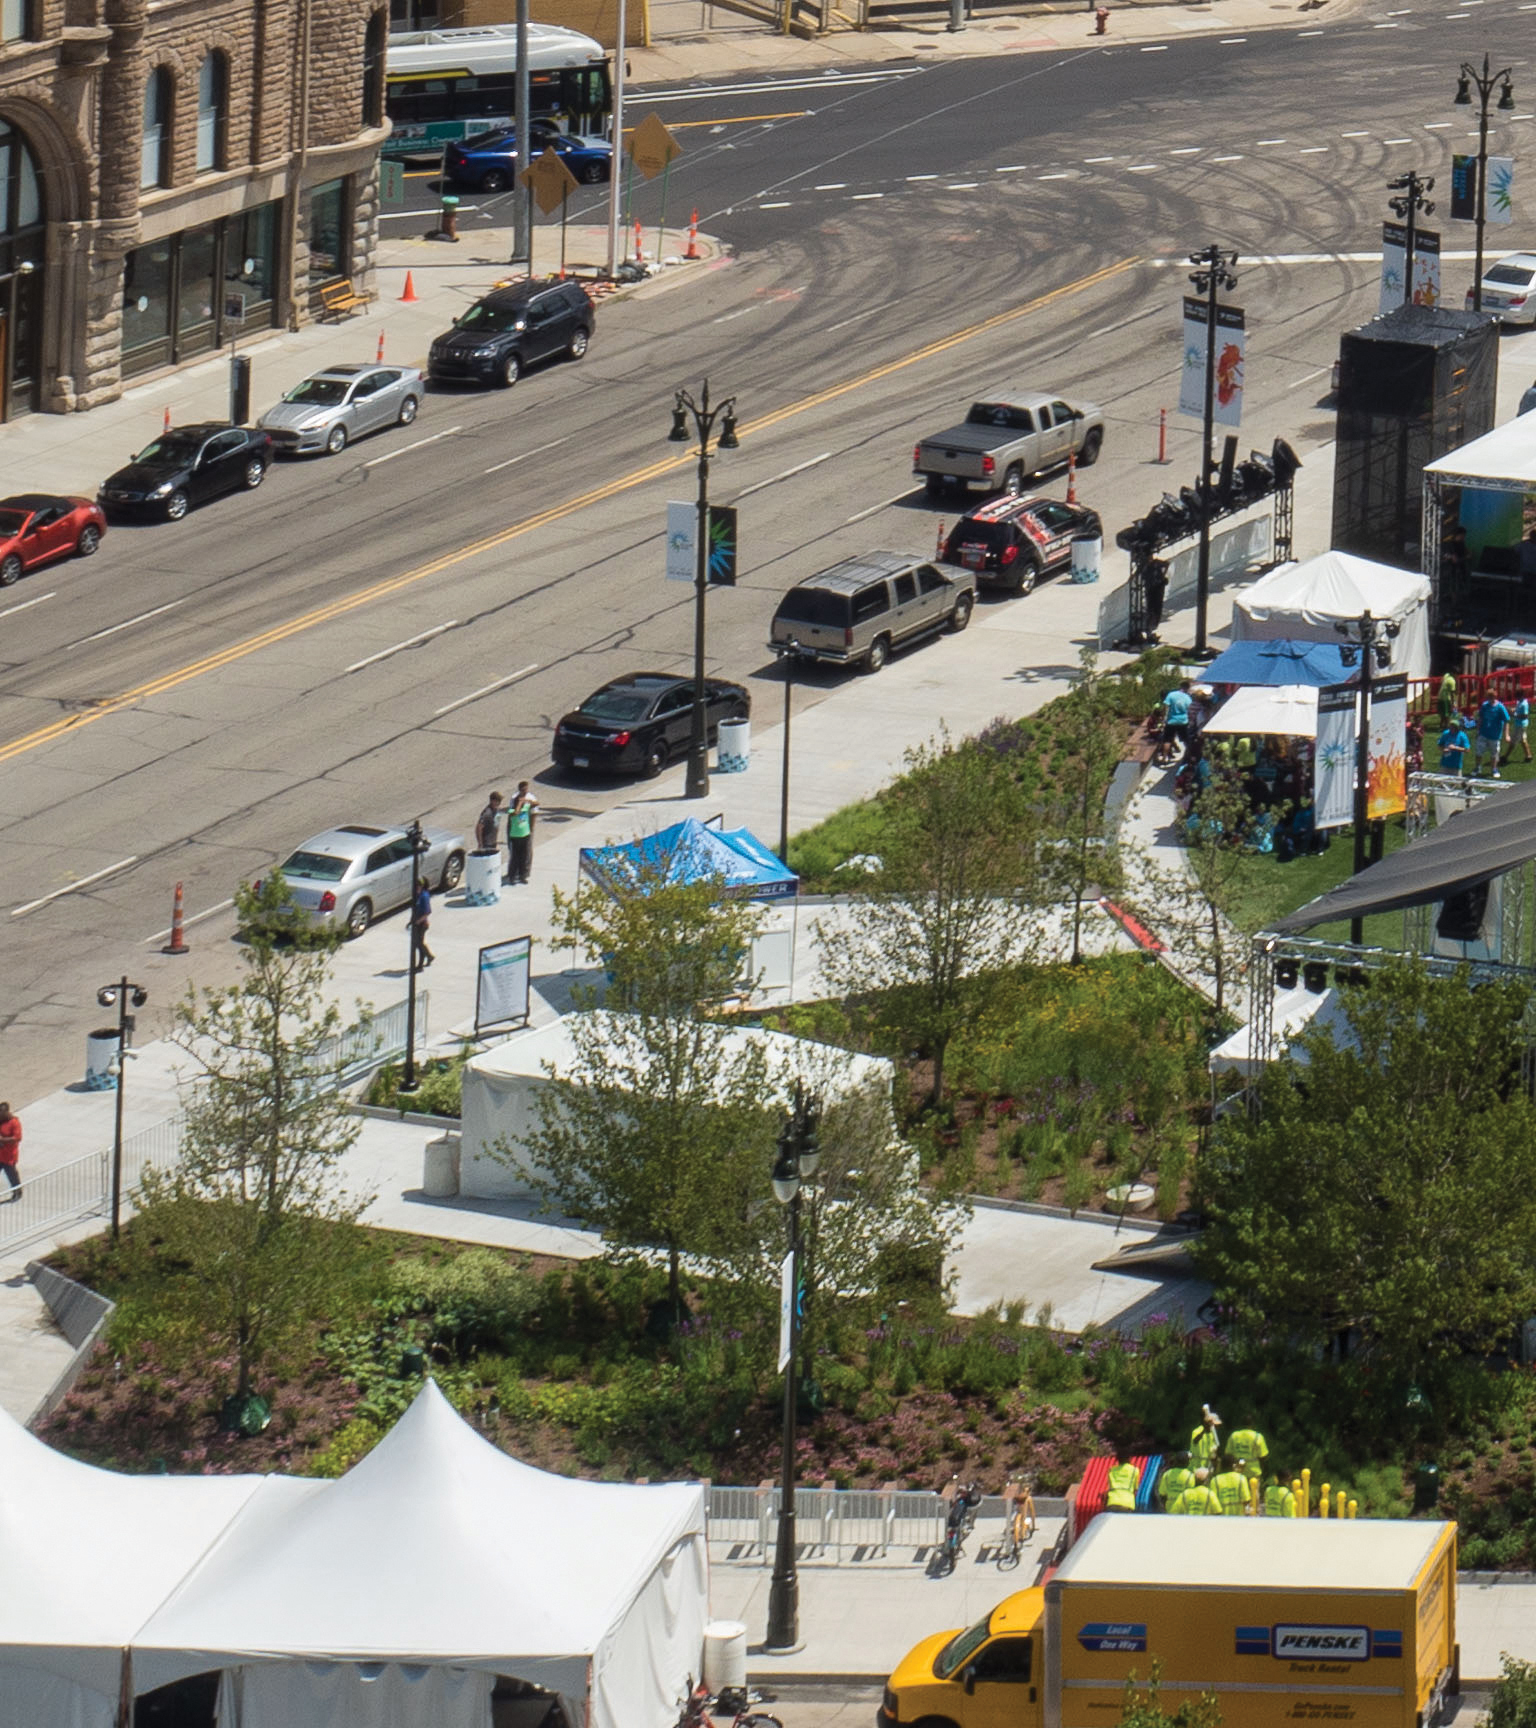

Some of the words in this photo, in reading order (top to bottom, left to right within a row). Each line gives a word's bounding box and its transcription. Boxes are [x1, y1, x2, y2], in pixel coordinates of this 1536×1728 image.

[1106, 1625, 1132, 1635] Local
[1100, 1640, 1117, 1650] One
[1118, 1640, 1138, 1651] Way
[1280, 1635, 1364, 1650] PENSKE
